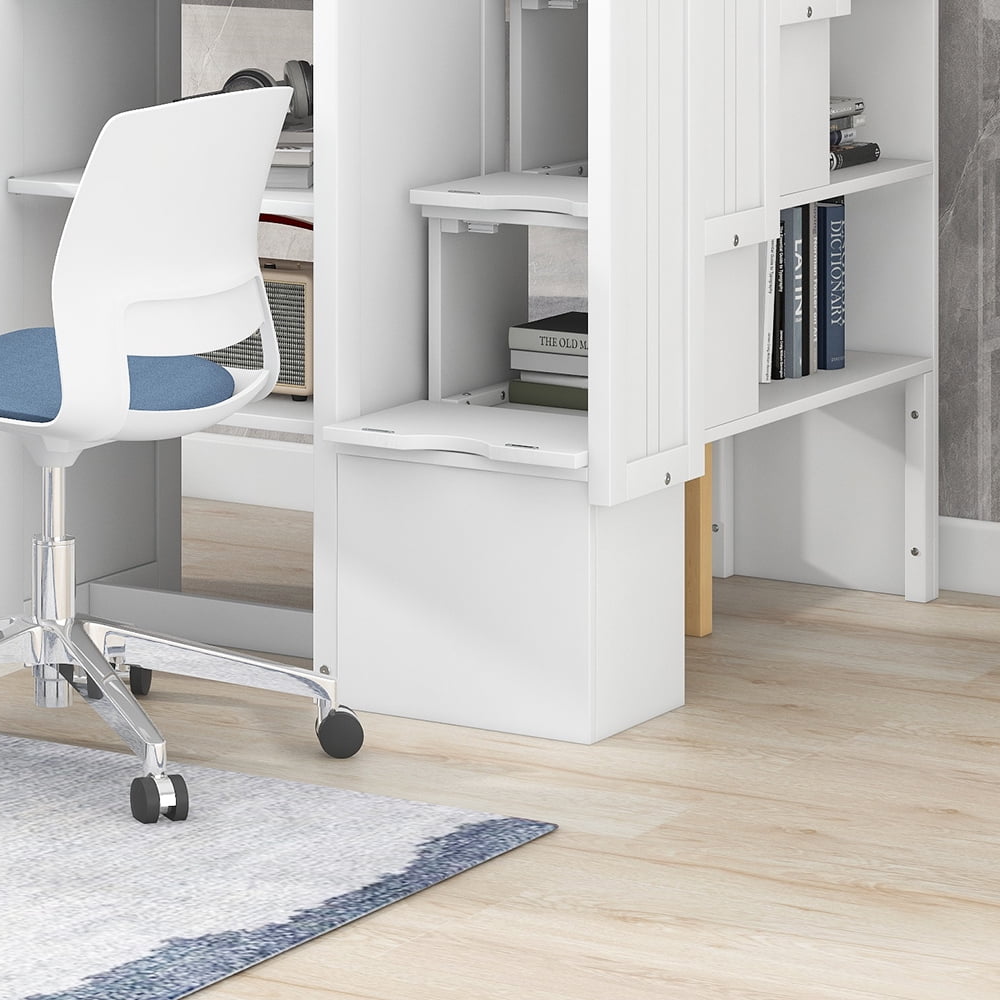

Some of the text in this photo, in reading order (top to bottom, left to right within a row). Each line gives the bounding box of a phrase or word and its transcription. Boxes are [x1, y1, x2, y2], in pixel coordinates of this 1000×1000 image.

[831, 220, 842, 326] DICTIONARY
[539, 336, 588, 350] THE OLD M
